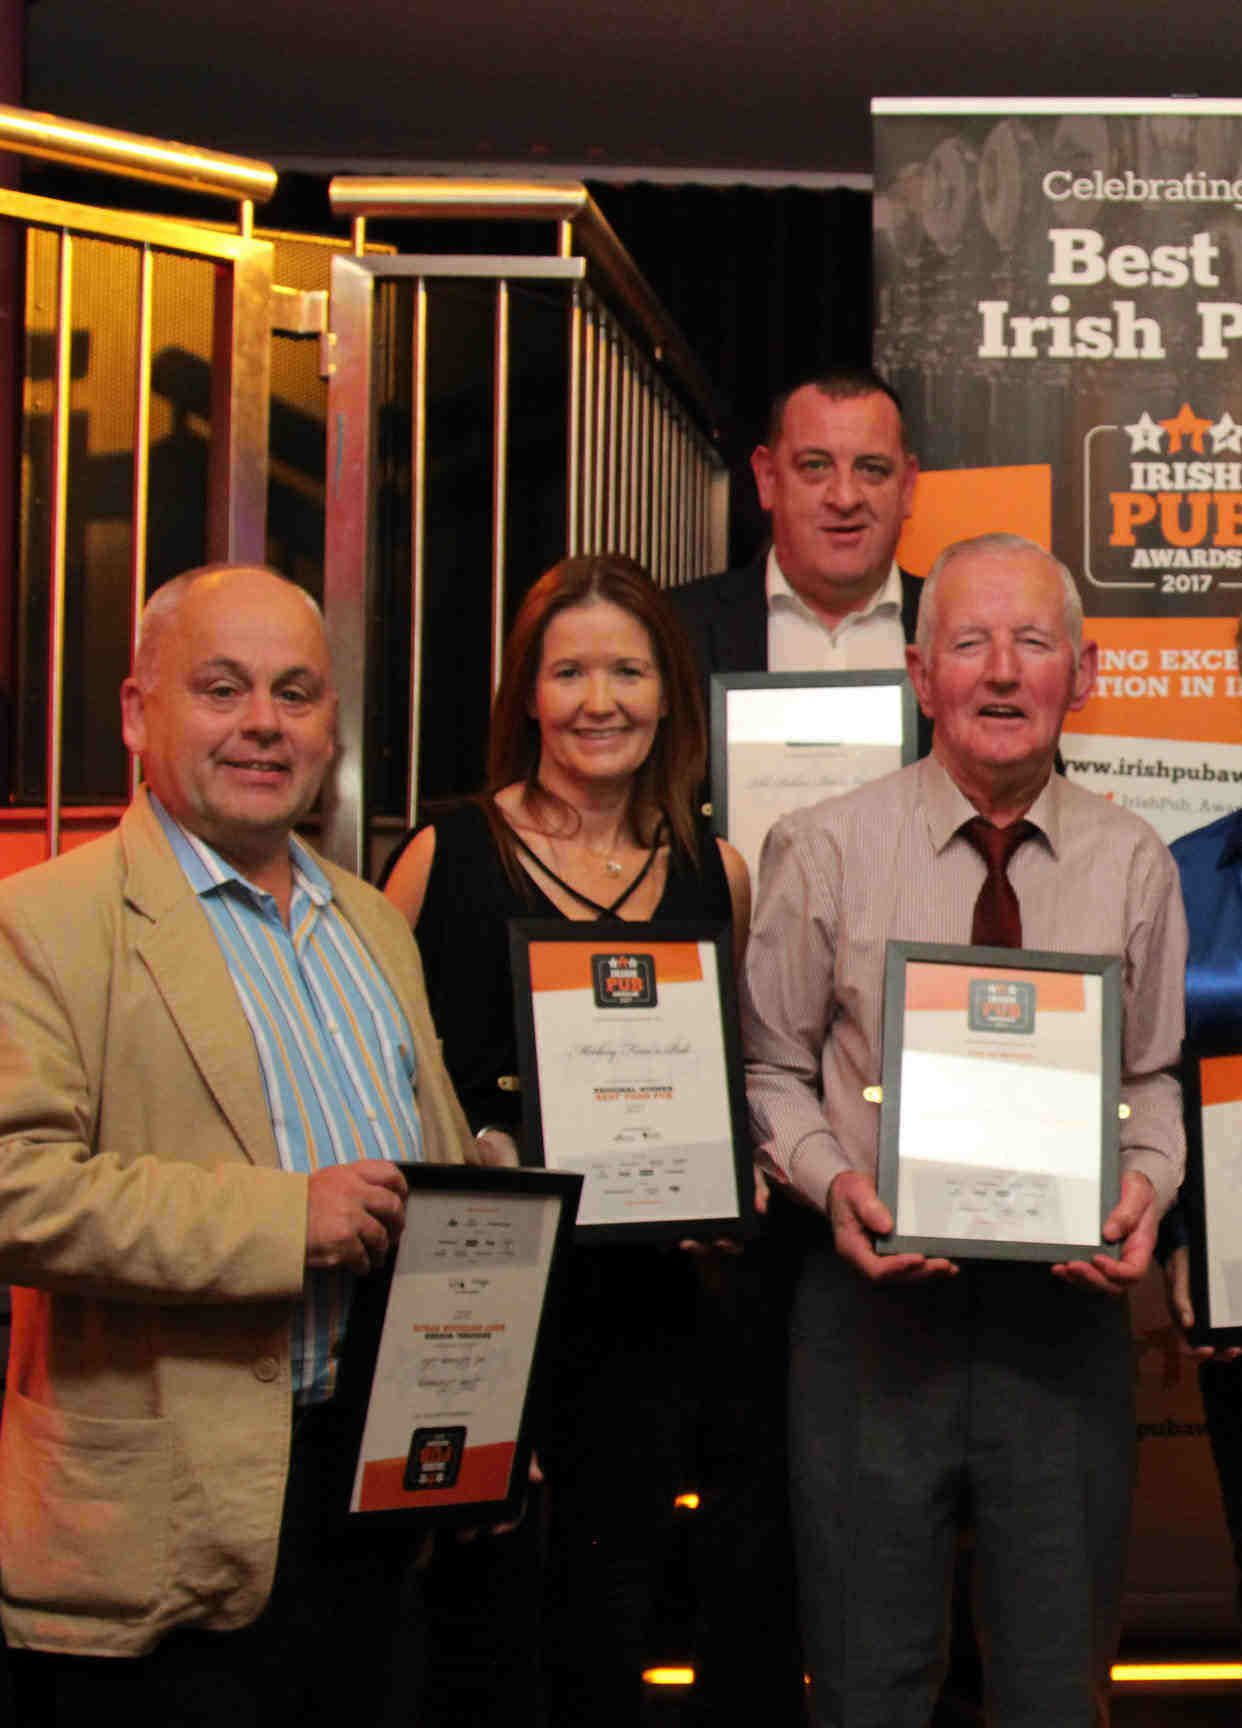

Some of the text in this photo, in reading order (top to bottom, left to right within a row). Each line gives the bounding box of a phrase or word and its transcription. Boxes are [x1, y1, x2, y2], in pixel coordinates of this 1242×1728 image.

[1048, 227, 1220, 288] Best
[978, 295, 1166, 359] Irish
[1130, 461, 1242, 492] IRISH
[1131, 548, 1242, 570] AWARDS
[1161, 574, 1212, 593] 2017
[1181, 676, 1214, 697] IN
